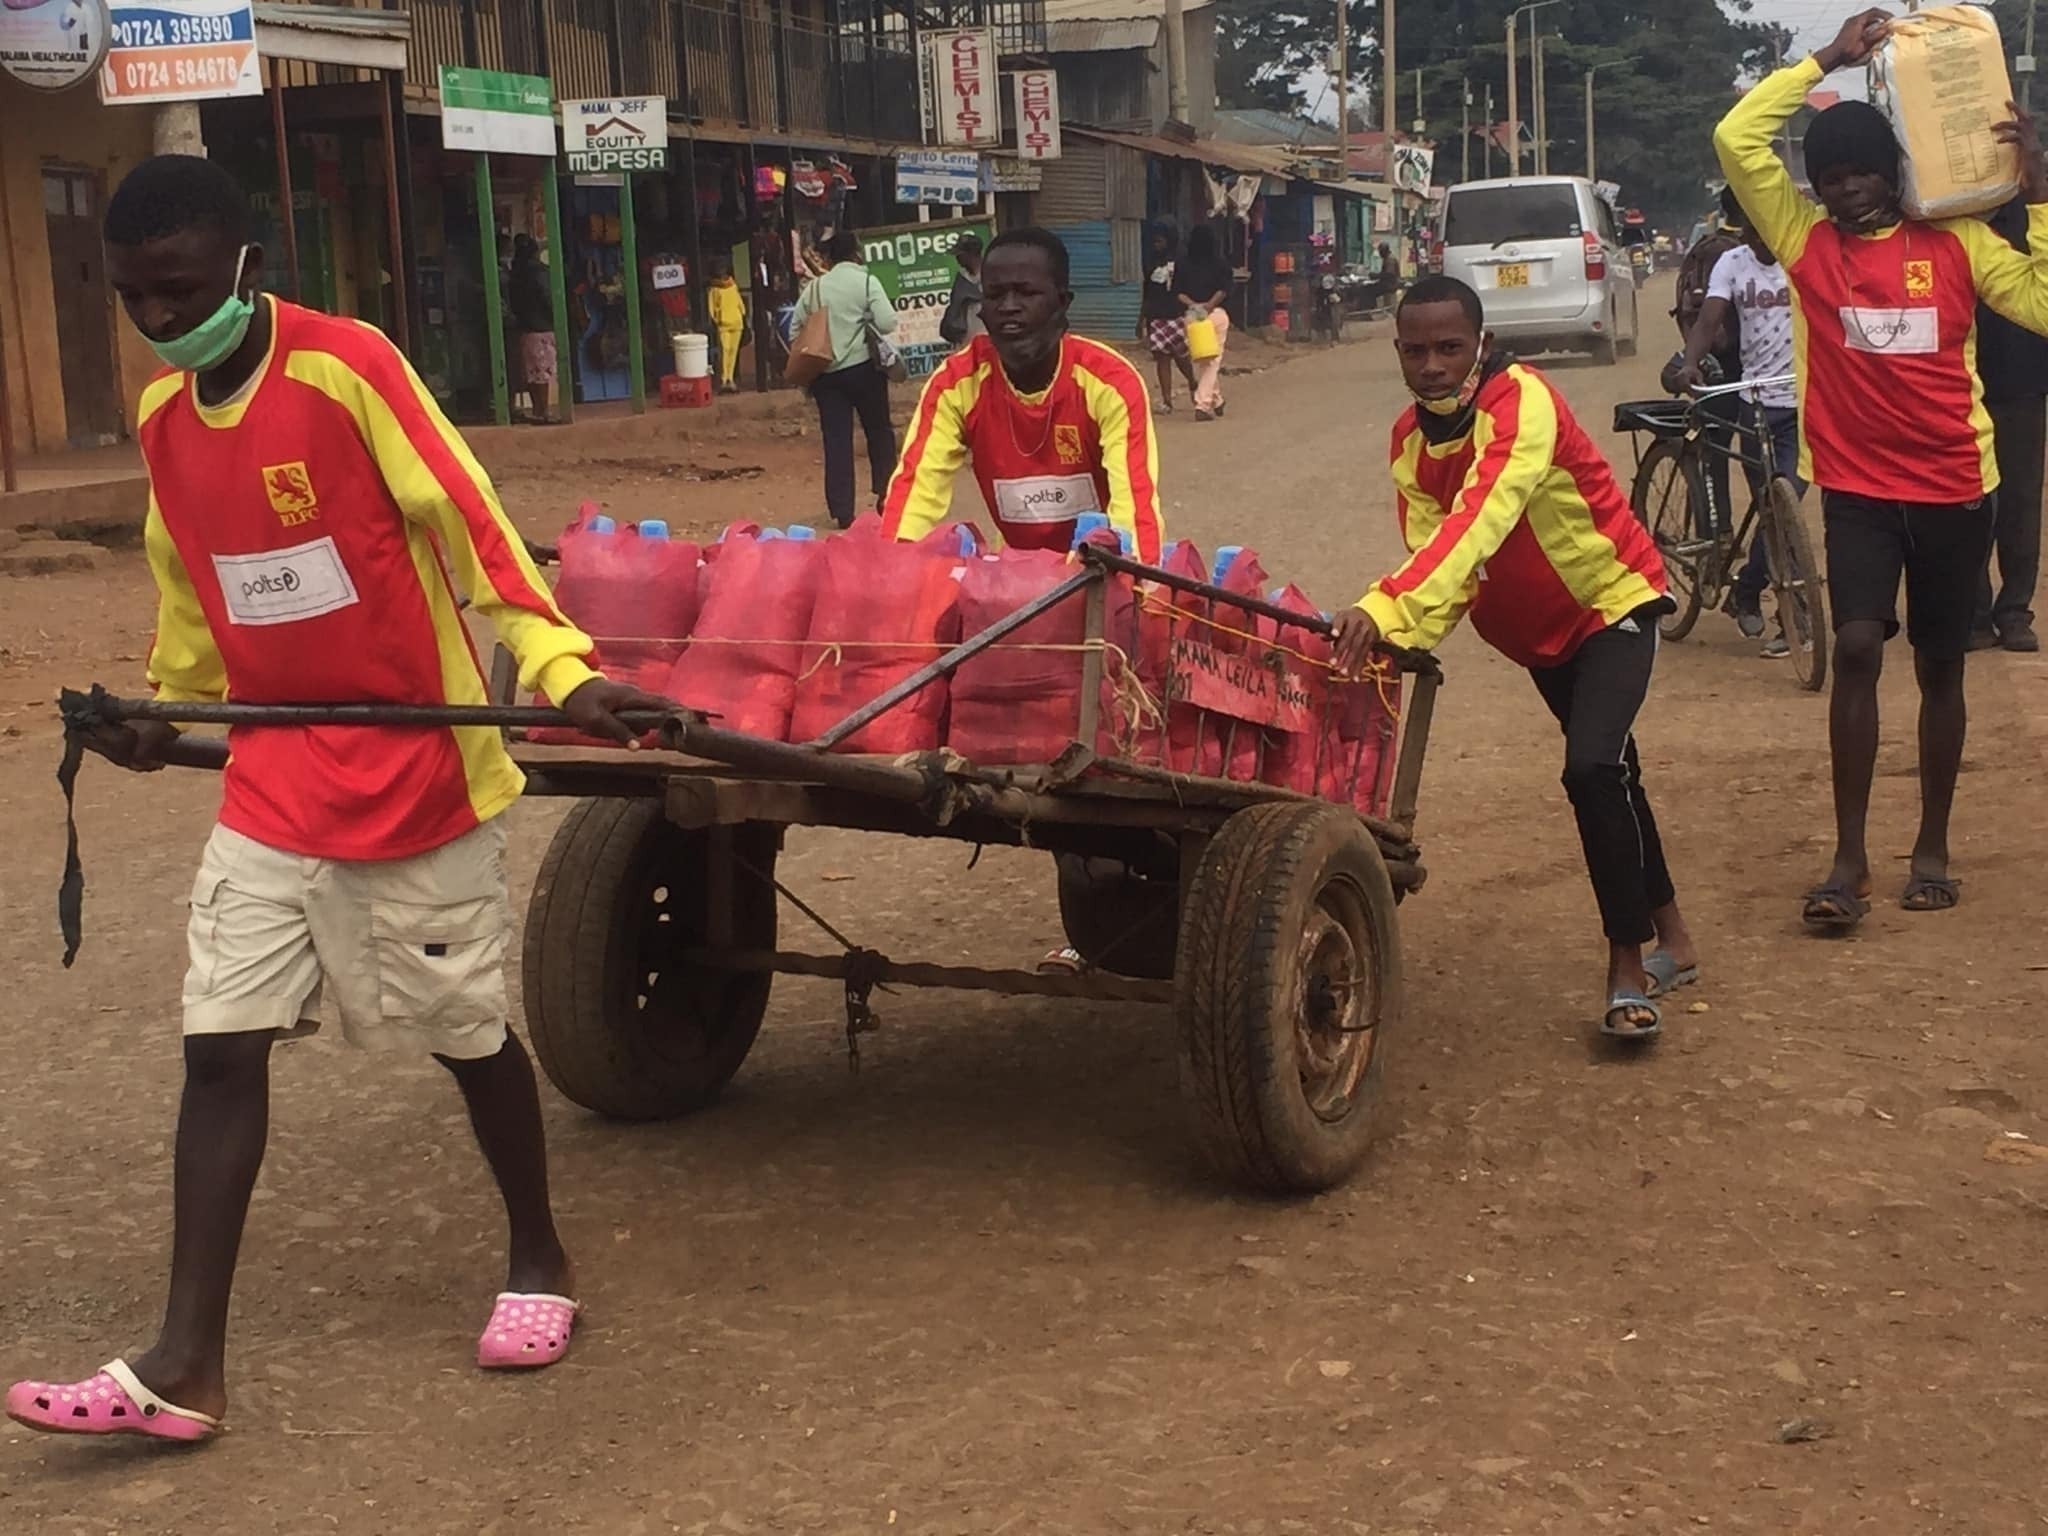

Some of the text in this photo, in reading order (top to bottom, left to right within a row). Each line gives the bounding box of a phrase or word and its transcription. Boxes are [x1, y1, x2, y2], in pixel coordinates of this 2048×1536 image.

[122, 16, 233, 46] 0724 395990
[32, 52, 88, 62] HEALTHCARE
[126, 56, 238, 89] 0724 584678
[951, 35, 982, 142] CHEMIST
[581, 100, 648, 115] MAMA JEFF
[1022, 73, 1052, 157] CHEMIST
[586, 135, 647, 149] EQUITY
[279, 507, 321, 528] RLFC
[1176, 641, 1222, 679] MAMA
[1225, 660, 1267, 698] LEILA
